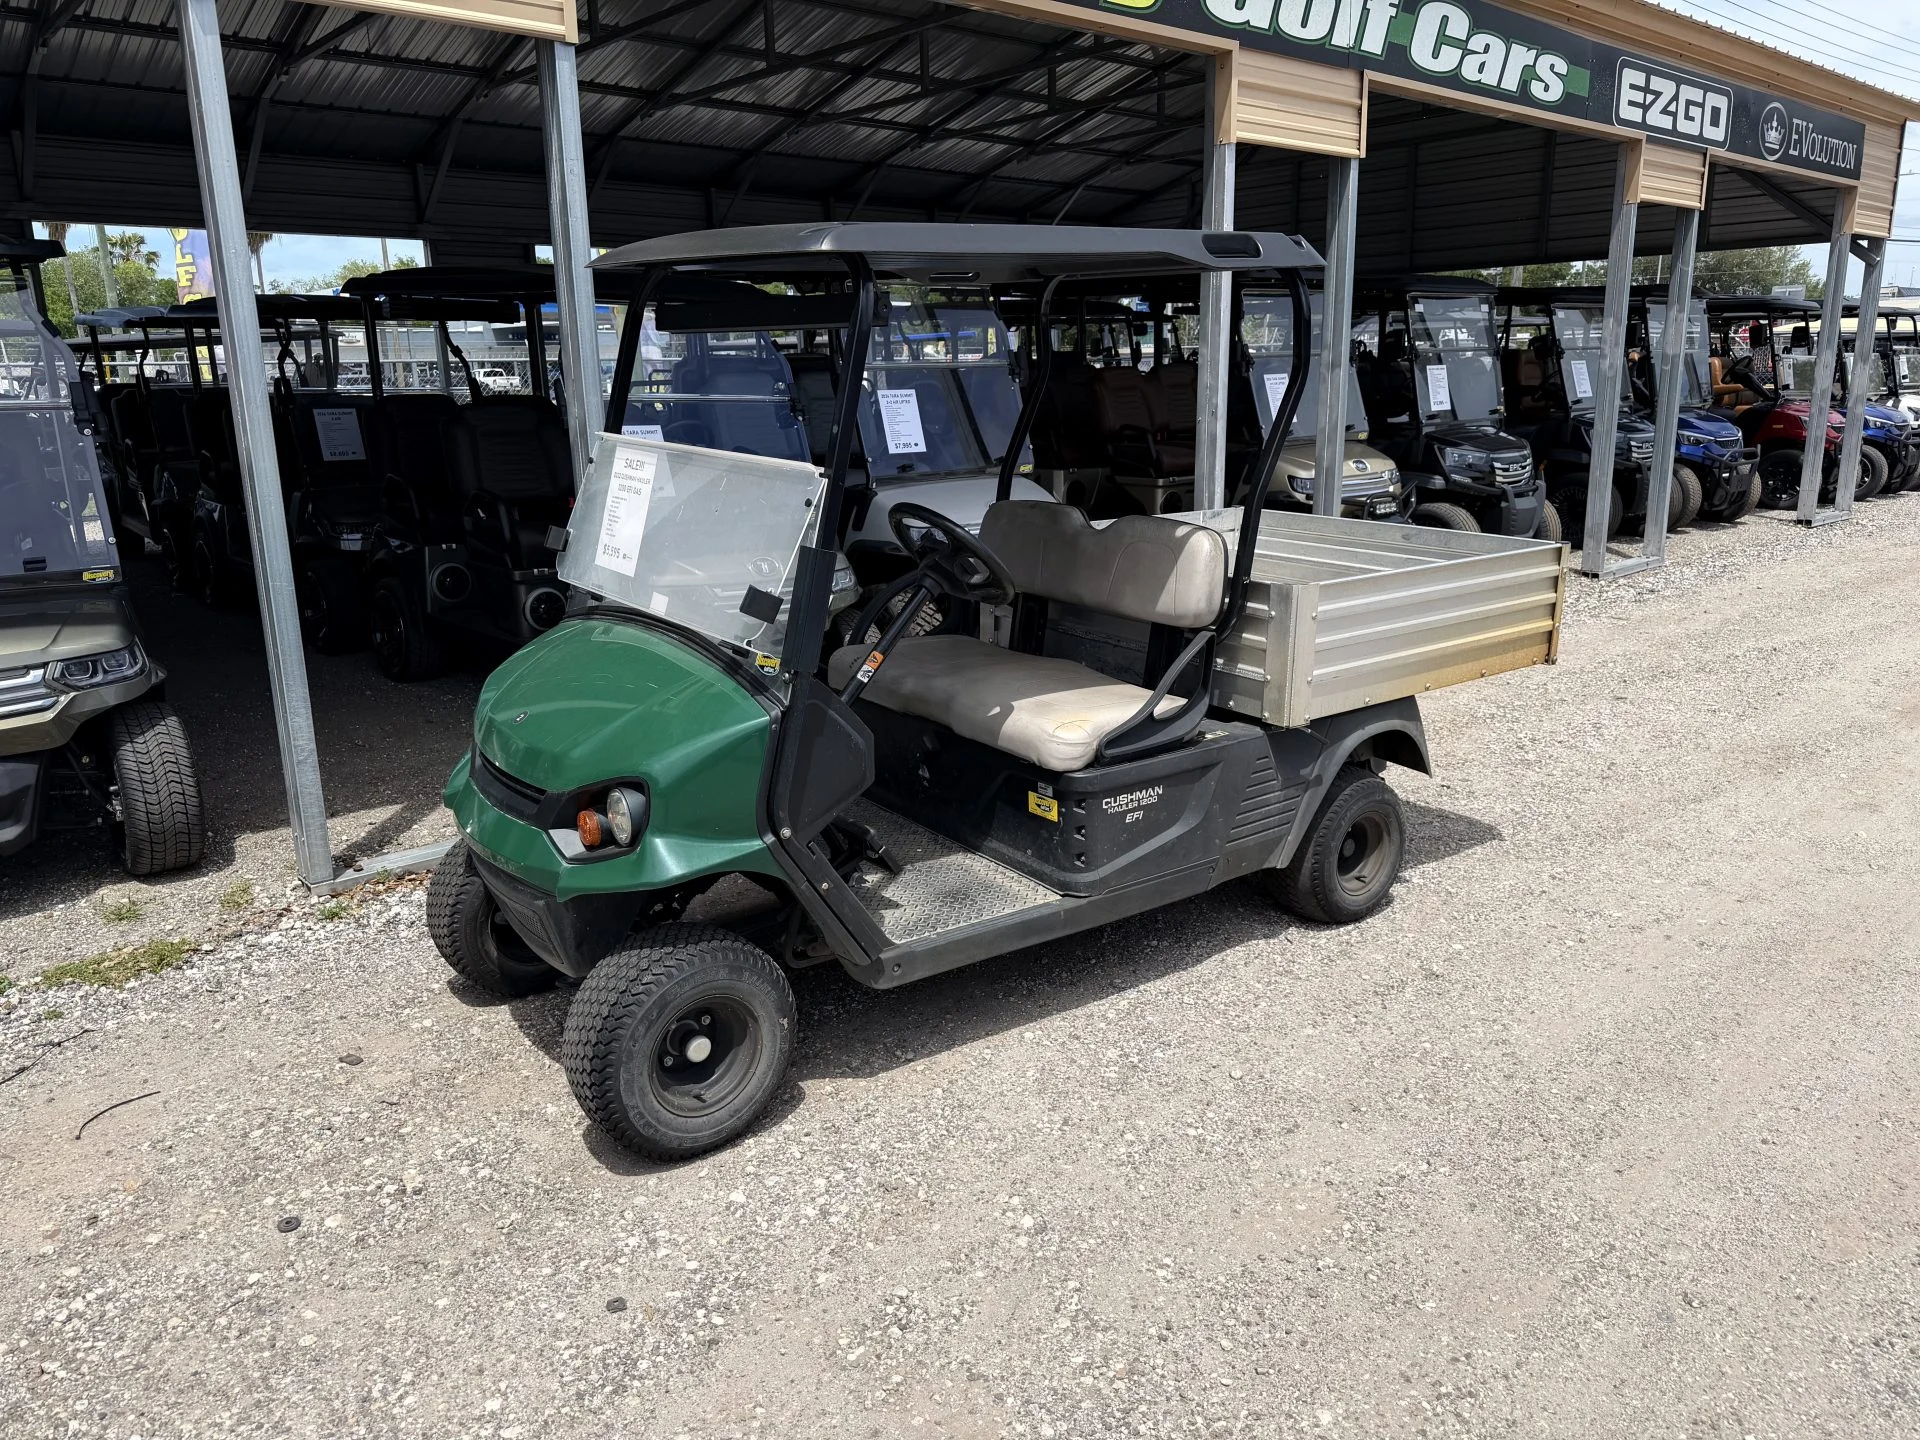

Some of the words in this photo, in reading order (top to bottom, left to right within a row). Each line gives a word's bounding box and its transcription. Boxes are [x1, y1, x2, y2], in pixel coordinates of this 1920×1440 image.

[1410, 1, 1568, 103] Cars
[1619, 68, 1729, 142] EZGO
[632, 486, 642, 496] GAS
[1102, 785, 1162, 809] CUSHMAN
[1107, 801, 1138, 815] HAULER
[1140, 795, 1158, 806] 1200
[1125, 810, 1144, 823] EFI
